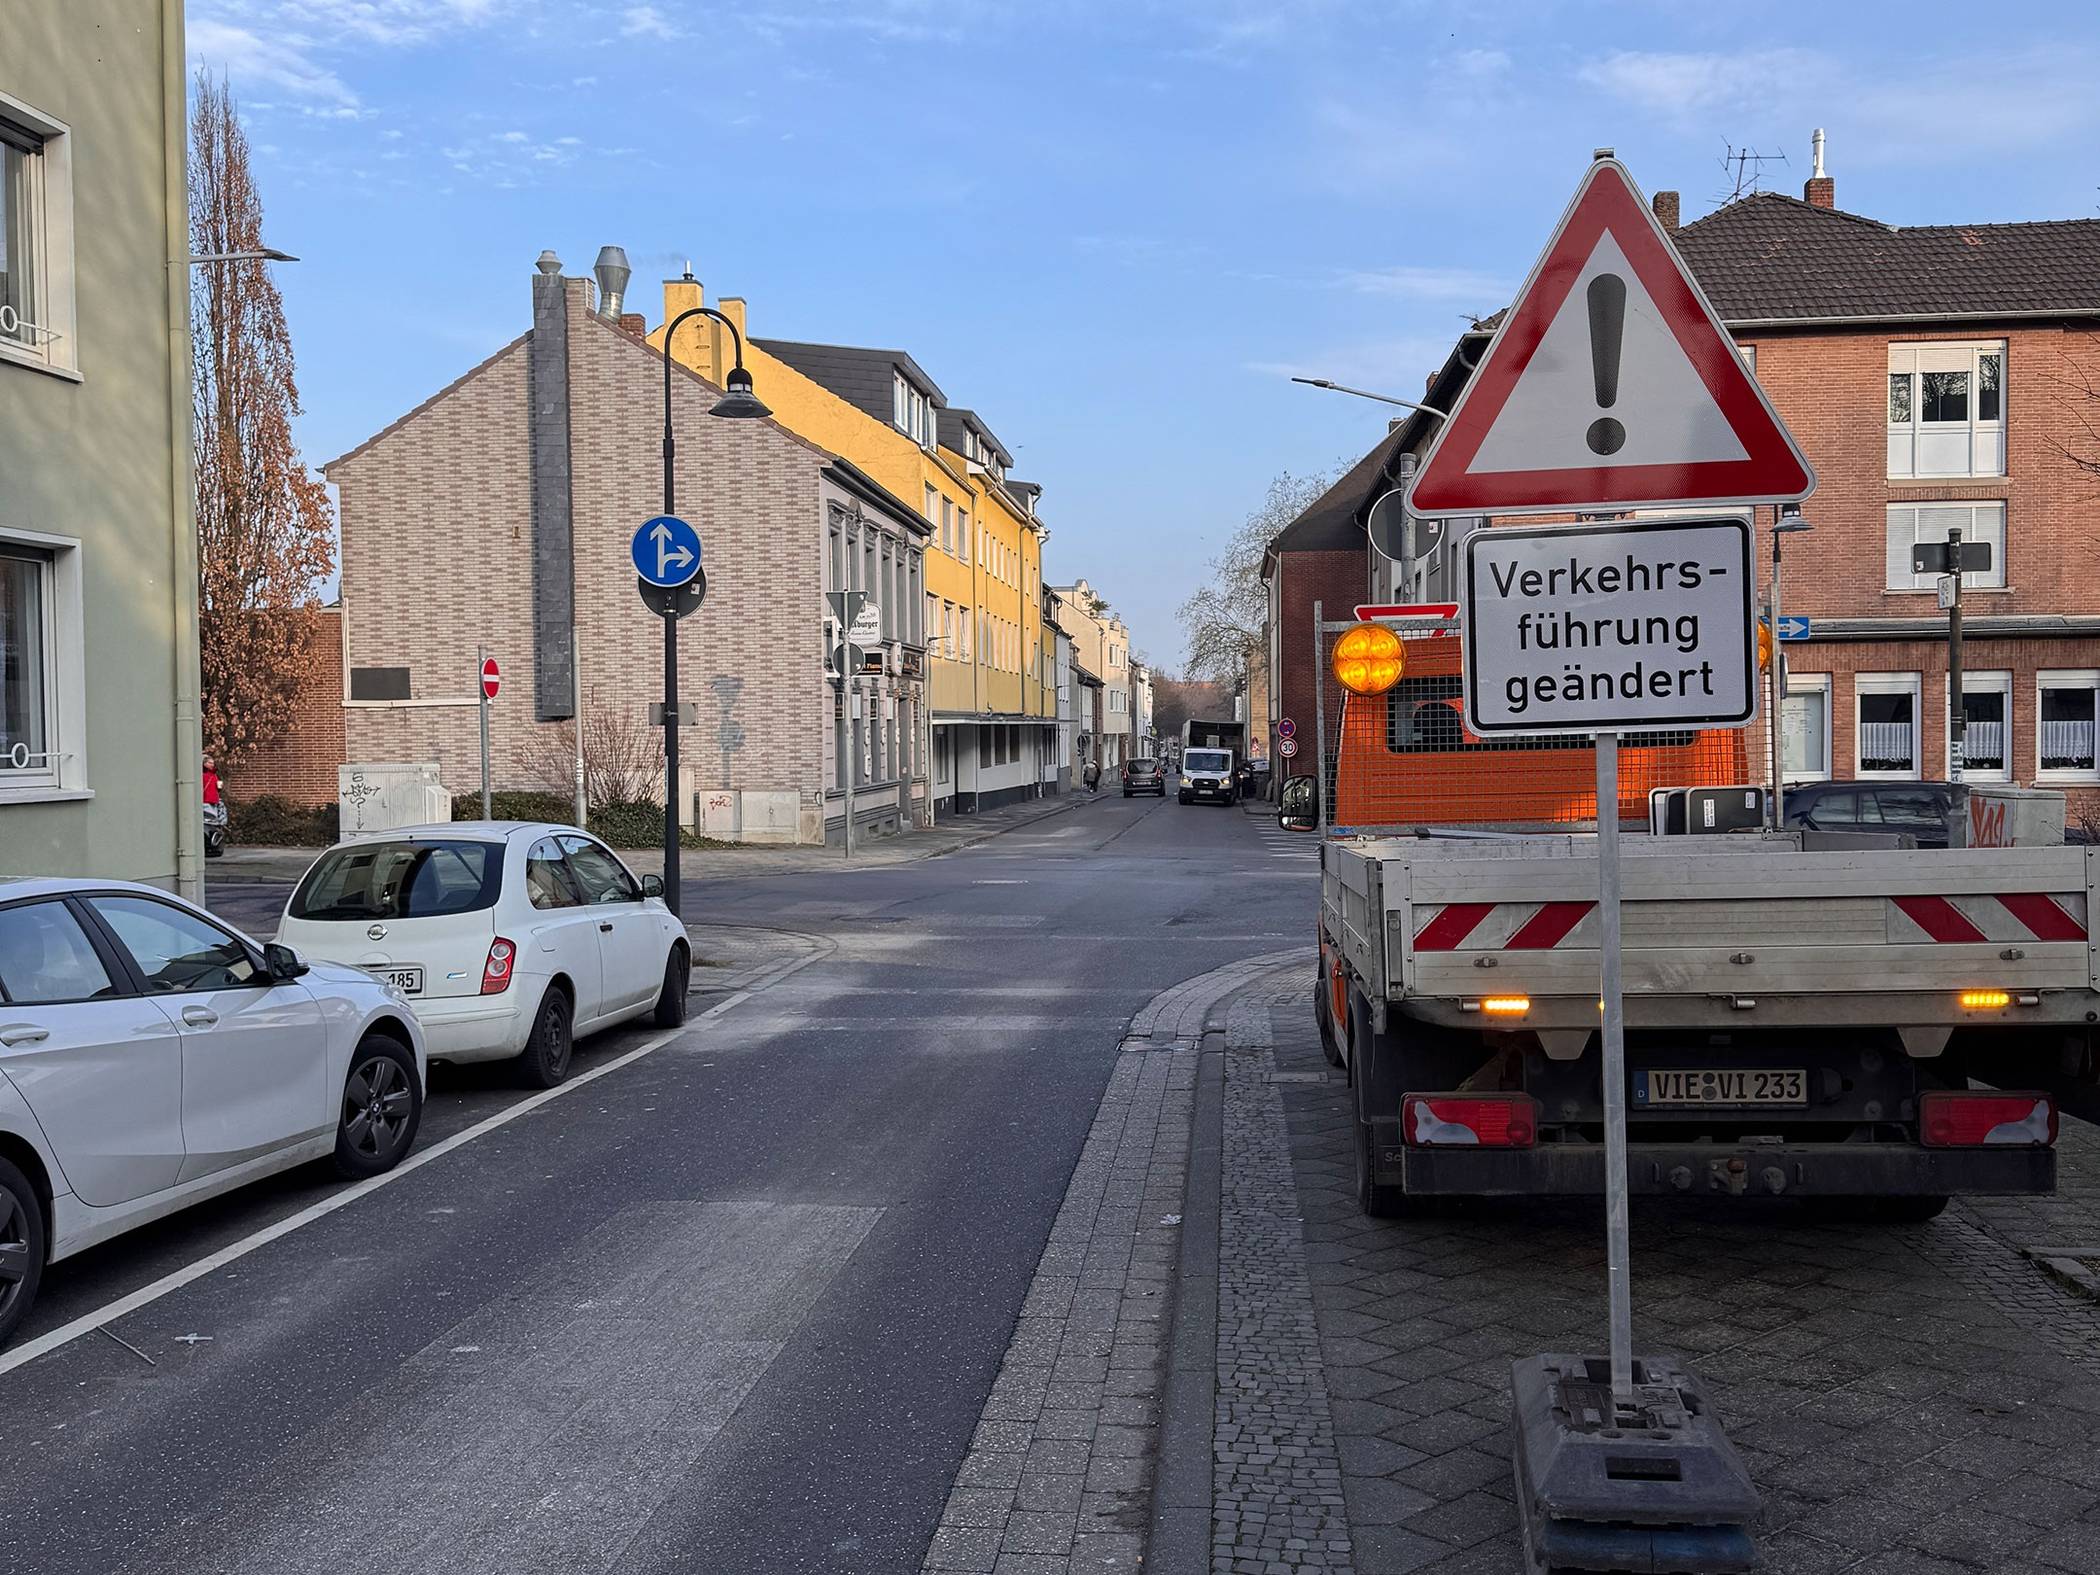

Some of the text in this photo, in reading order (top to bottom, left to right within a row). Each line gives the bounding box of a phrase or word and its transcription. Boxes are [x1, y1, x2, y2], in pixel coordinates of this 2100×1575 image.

[1489, 555, 1727, 598] Verkehrs-
[1517, 611, 1699, 653] führung
[1505, 661, 1714, 713] geändert
[1283, 743, 1293, 752] 30
[388, 972, 414, 988] 185
[1655, 1073, 1701, 1099] VIE
[1718, 1073, 1748, 1099] VI
[1754, 1073, 1801, 1099] 233
